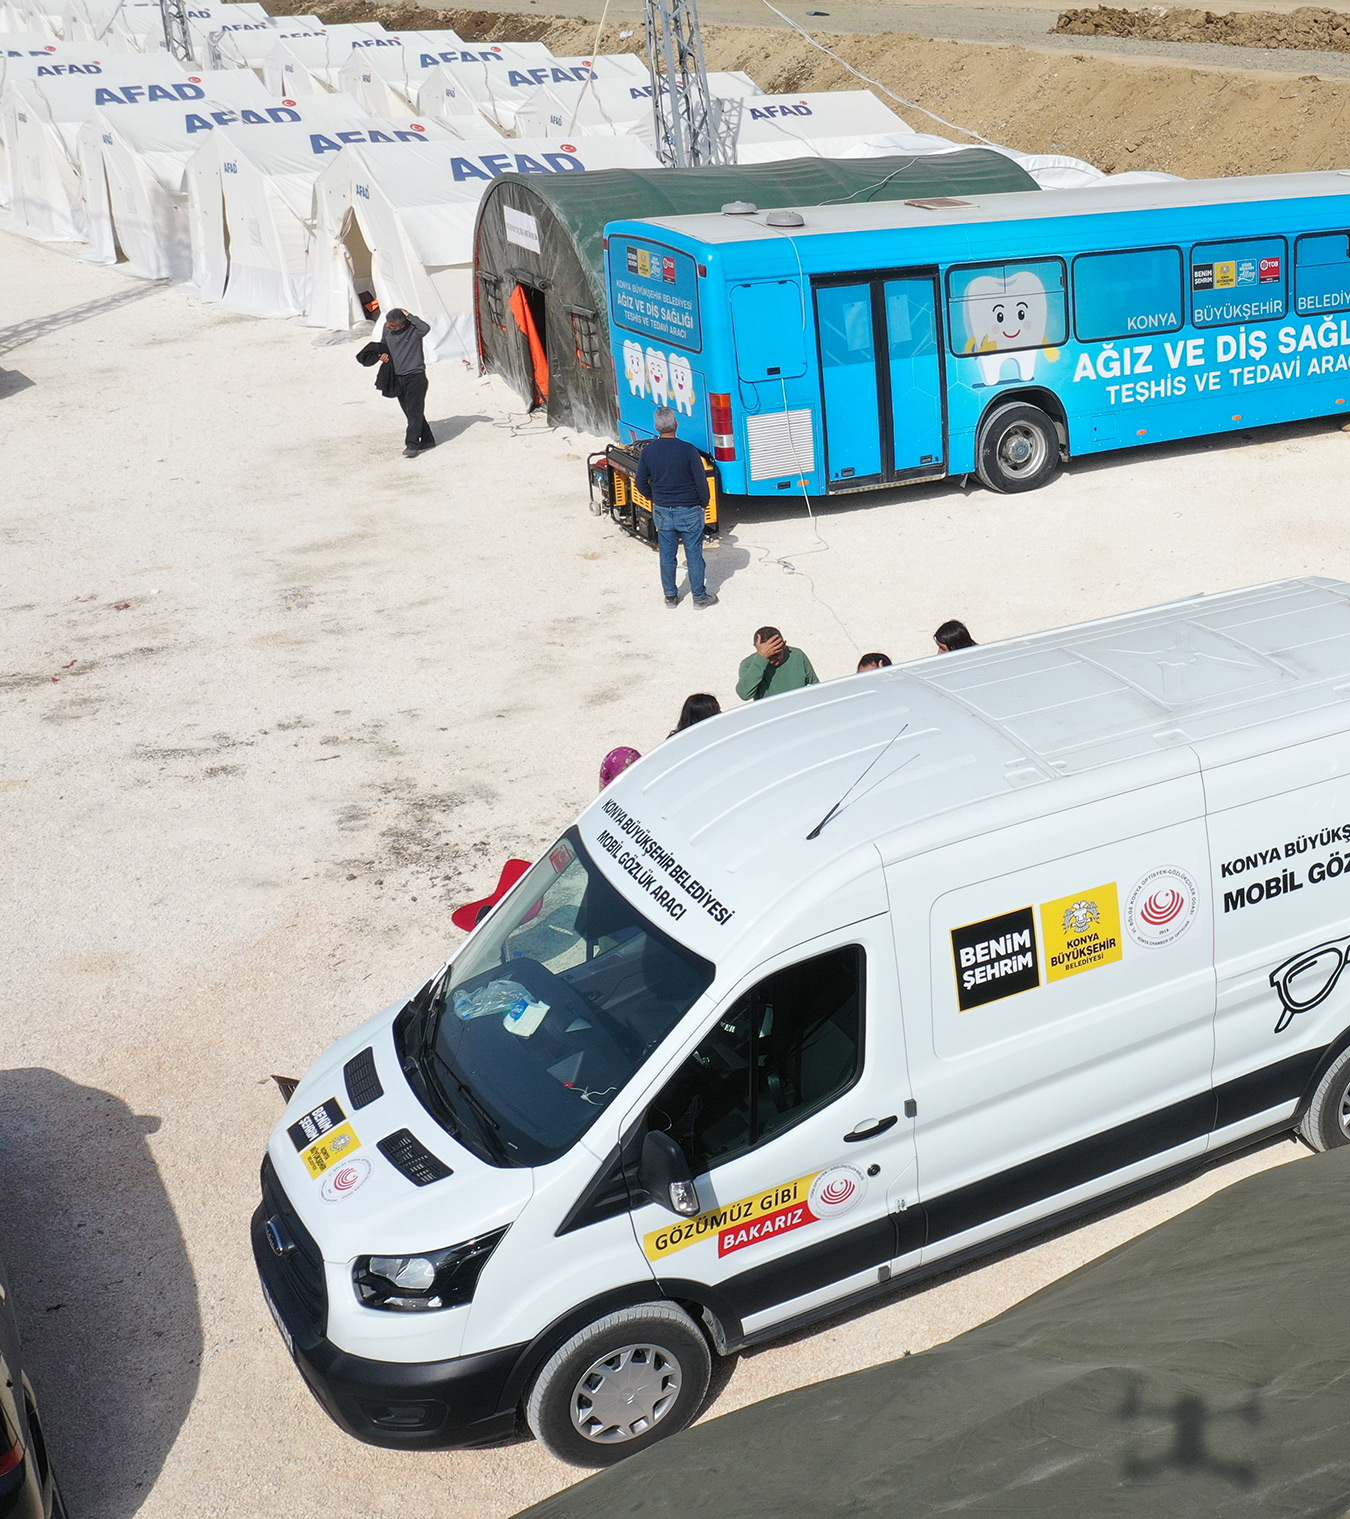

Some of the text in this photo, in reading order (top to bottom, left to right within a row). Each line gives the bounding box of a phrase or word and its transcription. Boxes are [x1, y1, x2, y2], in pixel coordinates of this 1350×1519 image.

[37, 64, 103, 76] AFAD
[508, 67, 598, 87] AFAD
[95, 83, 206, 105] AFAD
[185, 107, 302, 133] AFAD
[750, 105, 813, 120] AFAD
[224, 162, 238, 174] AFAD
[450, 153, 586, 181] AFAD
[617, 292, 694, 329] AĞIZ VE DİŞ SAĞLIĞI
[1127, 312, 1177, 331] KONYA
[1194, 297, 1283, 323] BÜYÜKŞEHİR
[1072, 342, 1153, 383] AĞIZ
[1163, 338, 1205, 370] VE
[1216, 326, 1268, 363] DİŞ
[1105, 373, 1187, 405] TEŞHİS
[1194, 370, 1221, 392] VE
[1229, 355, 1301, 387] TEDAVİ
[596, 830, 624, 860] MOBİL
[617, 851, 657, 892] GÖZLÜK
[649, 885, 688, 921] ARACI
[601, 798, 628, 826] KONYA
[620, 817, 675, 872] BÜYÜKŞEHİR
[668, 864, 736, 926] BELEDİYESİ
[1221, 847, 1282, 878] KONYA
[1130, 885, 1142, 905] KONYA
[1223, 868, 1304, 913] MOBİL
[959, 928, 1031, 968] BENİM
[1051, 937, 1117, 967] BÜYÜKŞEHİR
[1066, 932, 1100, 949] KONYA
[963, 951, 1033, 990] ŞEHRİM
[1065, 953, 1104, 971] BELEDİYESİ
[298, 1115, 320, 1142] ŞEHRİM
[311, 1106, 334, 1133] BENİM
[655, 1201, 753, 1250] GÖZÜMÜZ
[760, 1182, 798, 1211] GİBİ
[723, 1208, 804, 1250] BAKARIZ
